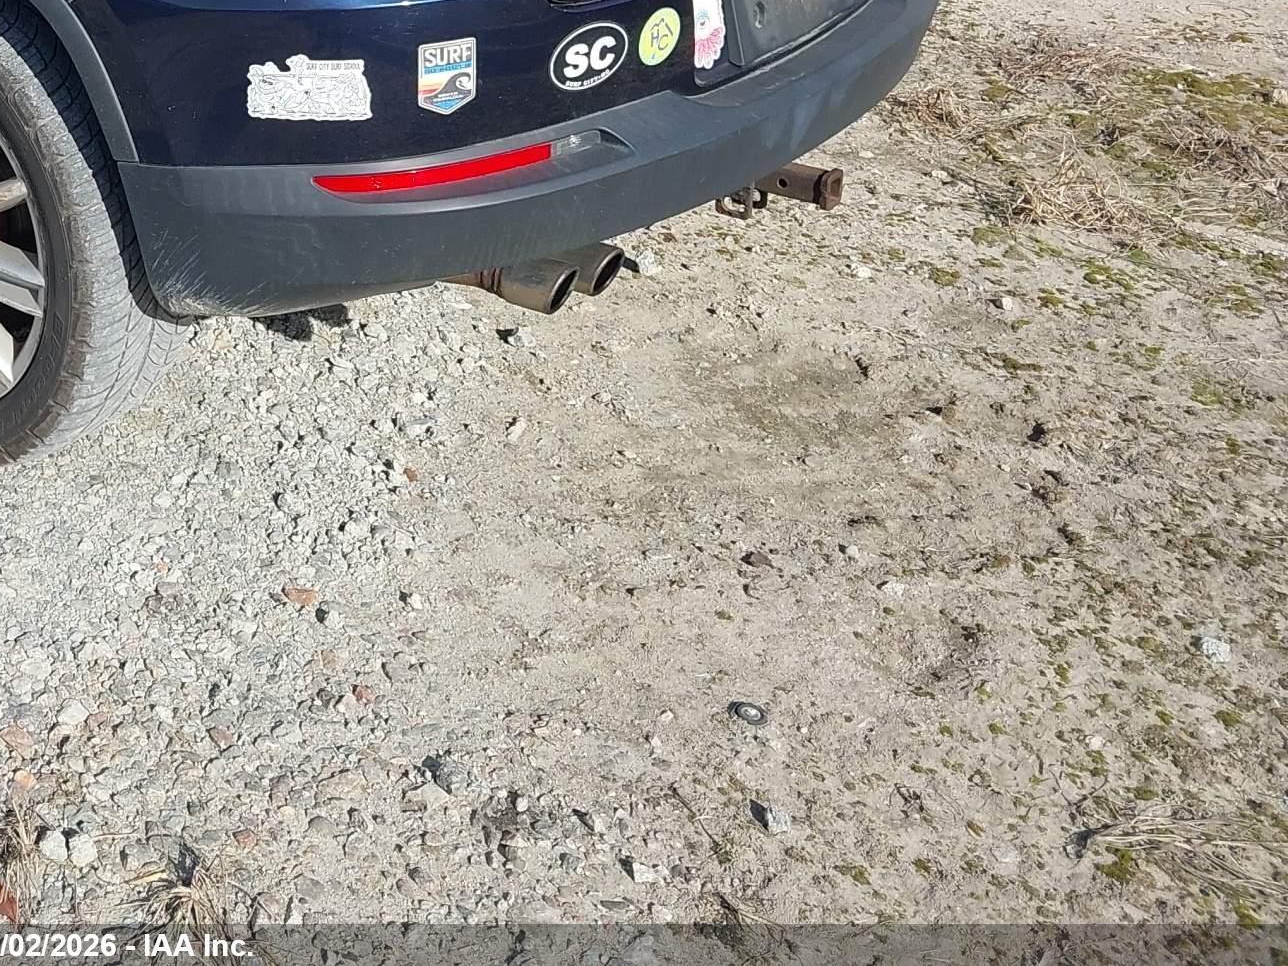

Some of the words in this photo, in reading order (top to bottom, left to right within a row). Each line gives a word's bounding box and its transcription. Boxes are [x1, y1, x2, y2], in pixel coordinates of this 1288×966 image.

[306, 62, 318, 70] SURF
[320, 62, 330, 70] CITY
[331, 62, 342, 70] SURF
[344, 62, 361, 70] SCHOOL
[423, 43, 472, 68] SURF
[562, 35, 617, 79] SC
